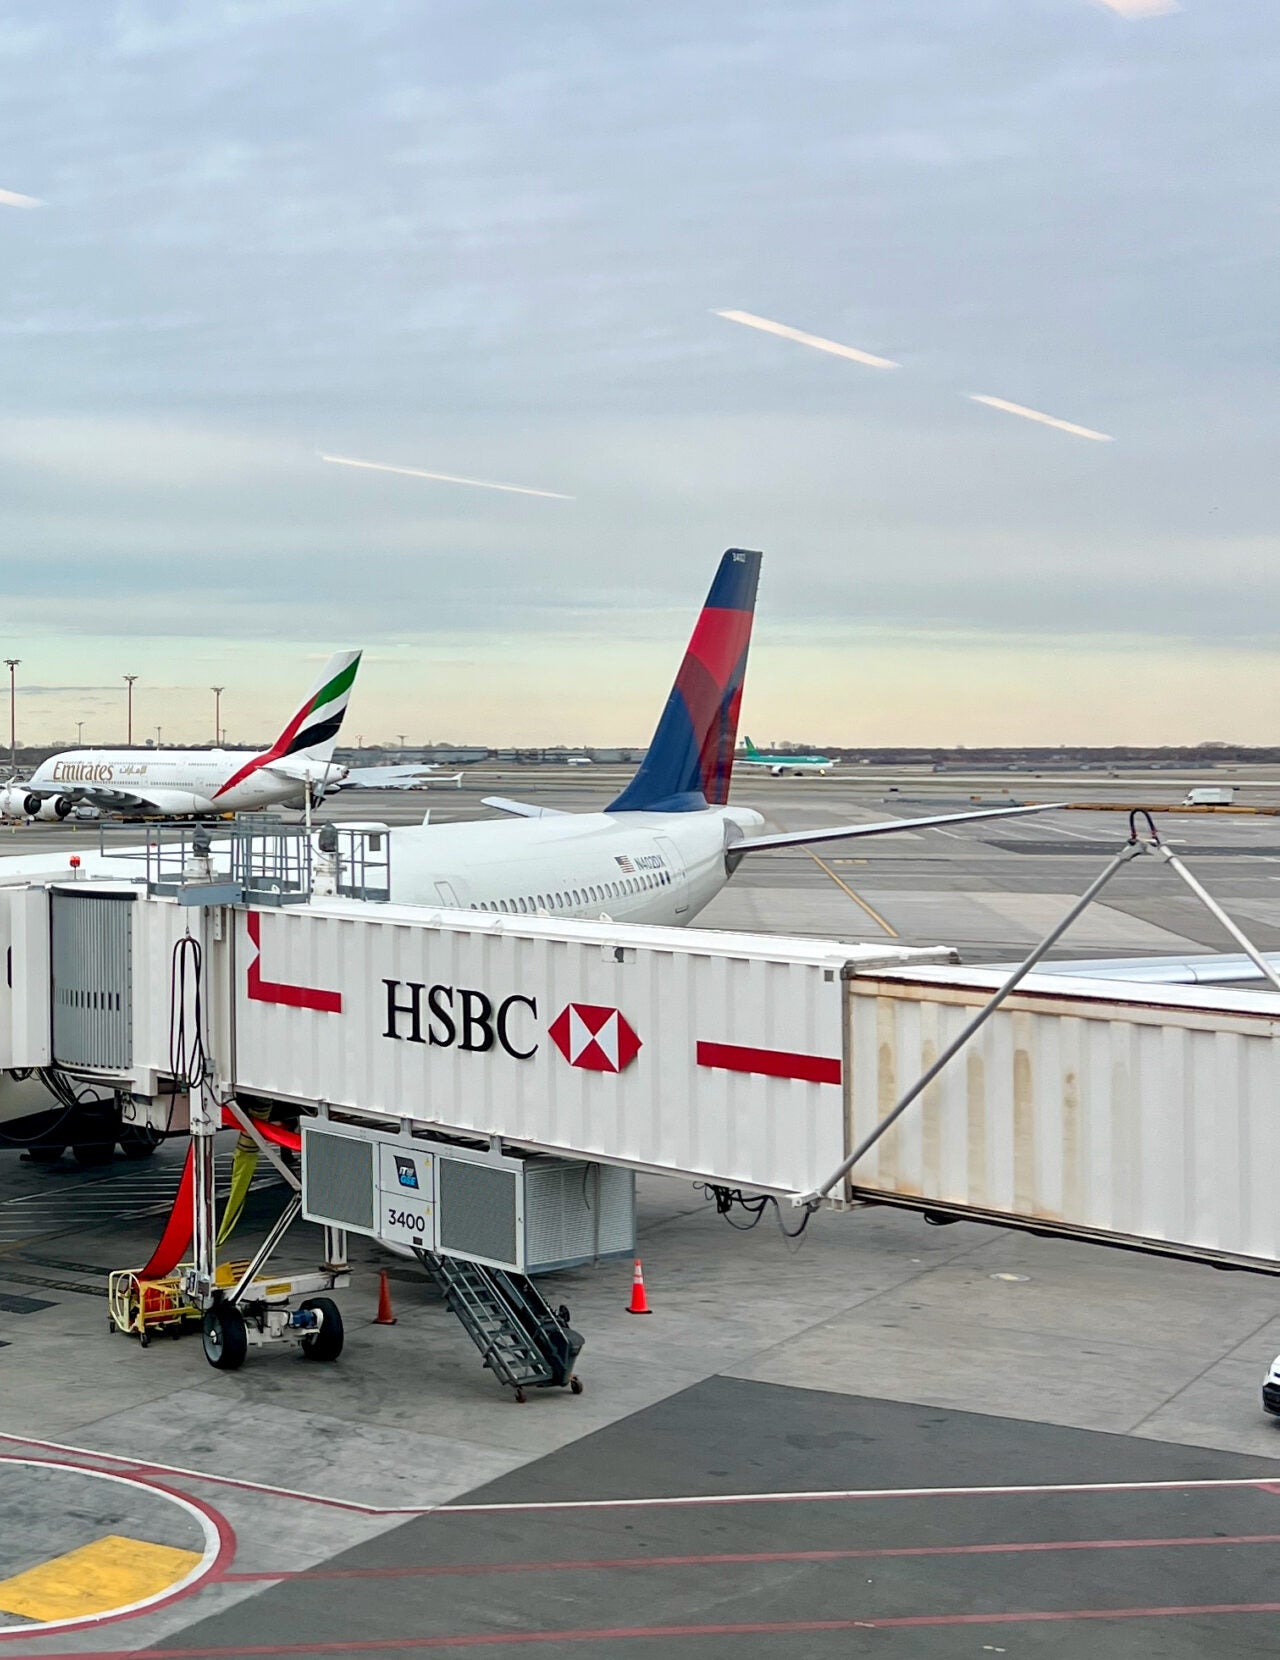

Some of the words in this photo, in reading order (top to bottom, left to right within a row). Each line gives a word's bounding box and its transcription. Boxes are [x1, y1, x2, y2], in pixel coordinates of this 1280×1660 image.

[53, 761, 114, 781] Emirates
[381, 978, 539, 1060] HSBC
[388, 1208, 426, 1232] 3400
